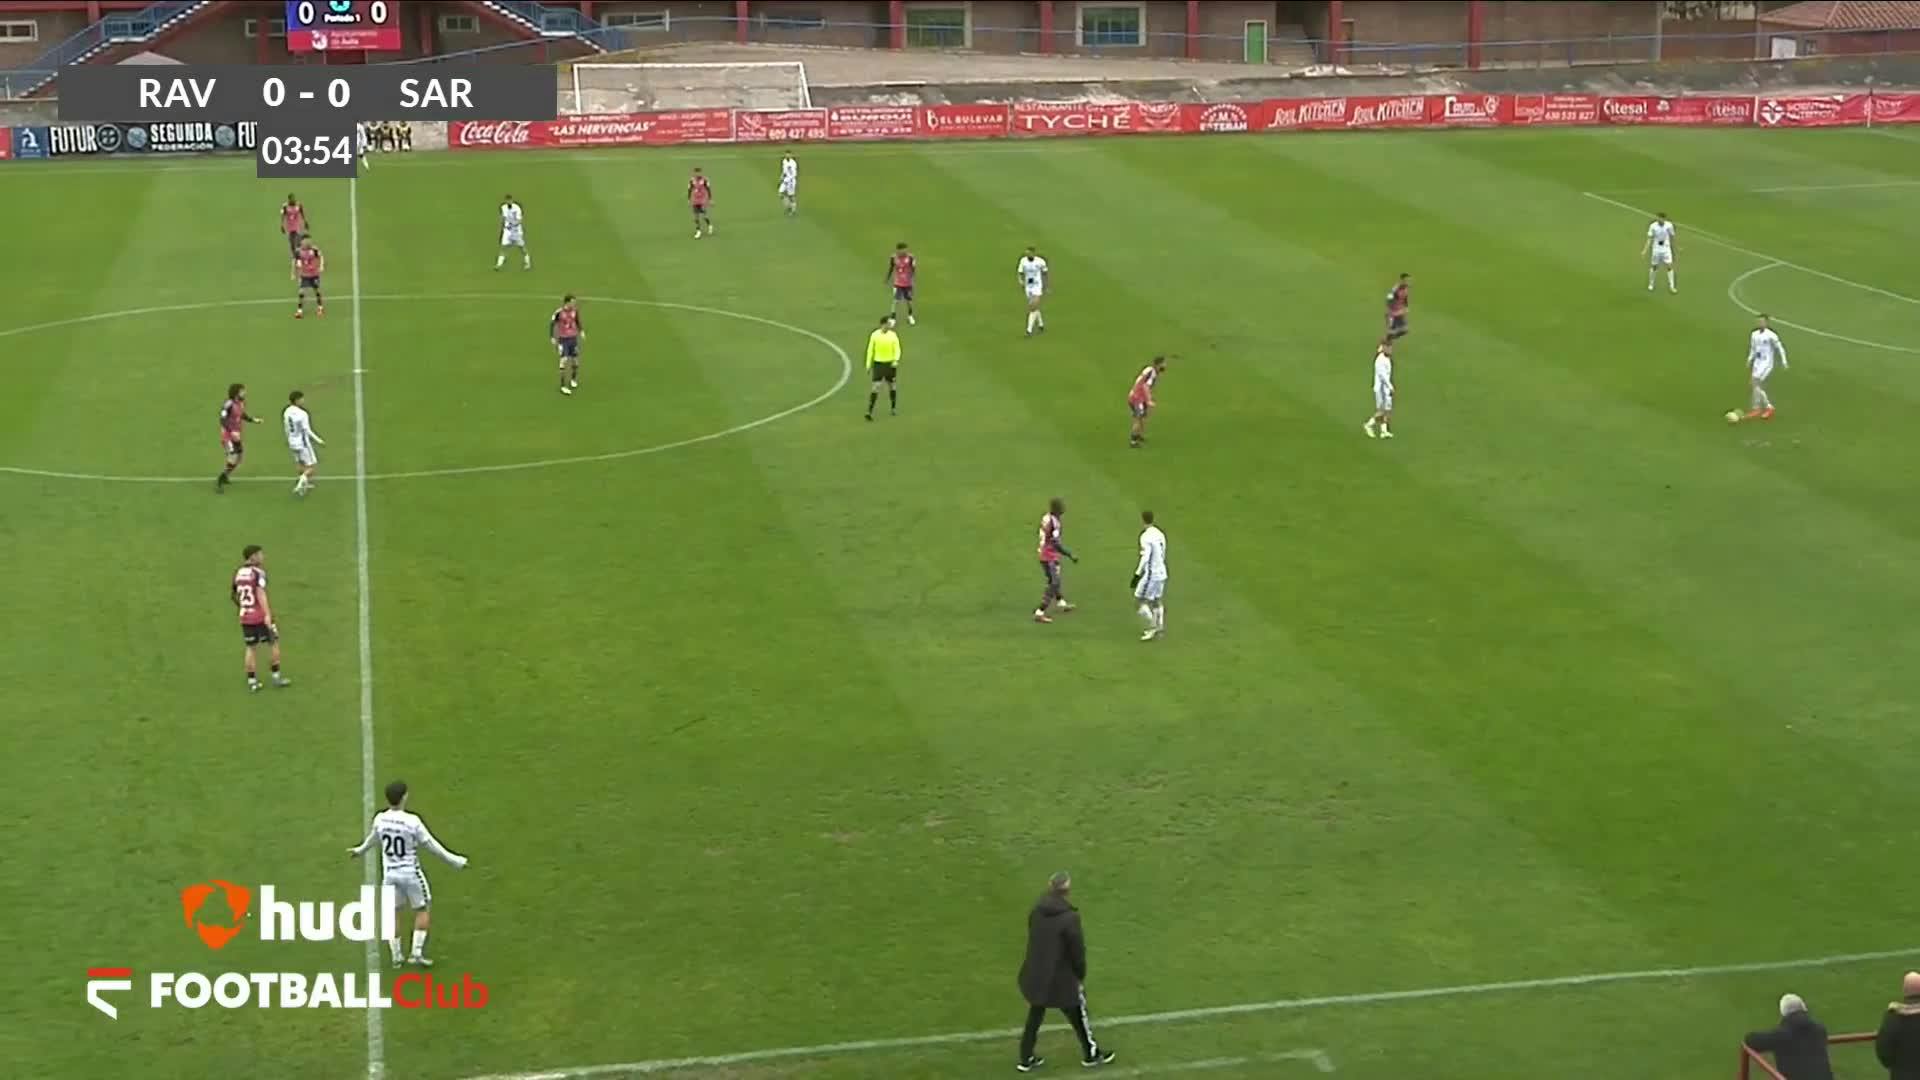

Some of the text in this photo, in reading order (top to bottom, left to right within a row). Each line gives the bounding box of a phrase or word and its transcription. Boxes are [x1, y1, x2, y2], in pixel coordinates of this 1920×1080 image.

[298, 1, 314, 24] 0
[370, 1, 387, 24] 0
[1018, 110, 1131, 129] TYCHÉ
[150, 122, 213, 143] SEGUNDA
[237, 585, 255, 606] 23
[382, 834, 406, 858] 20
